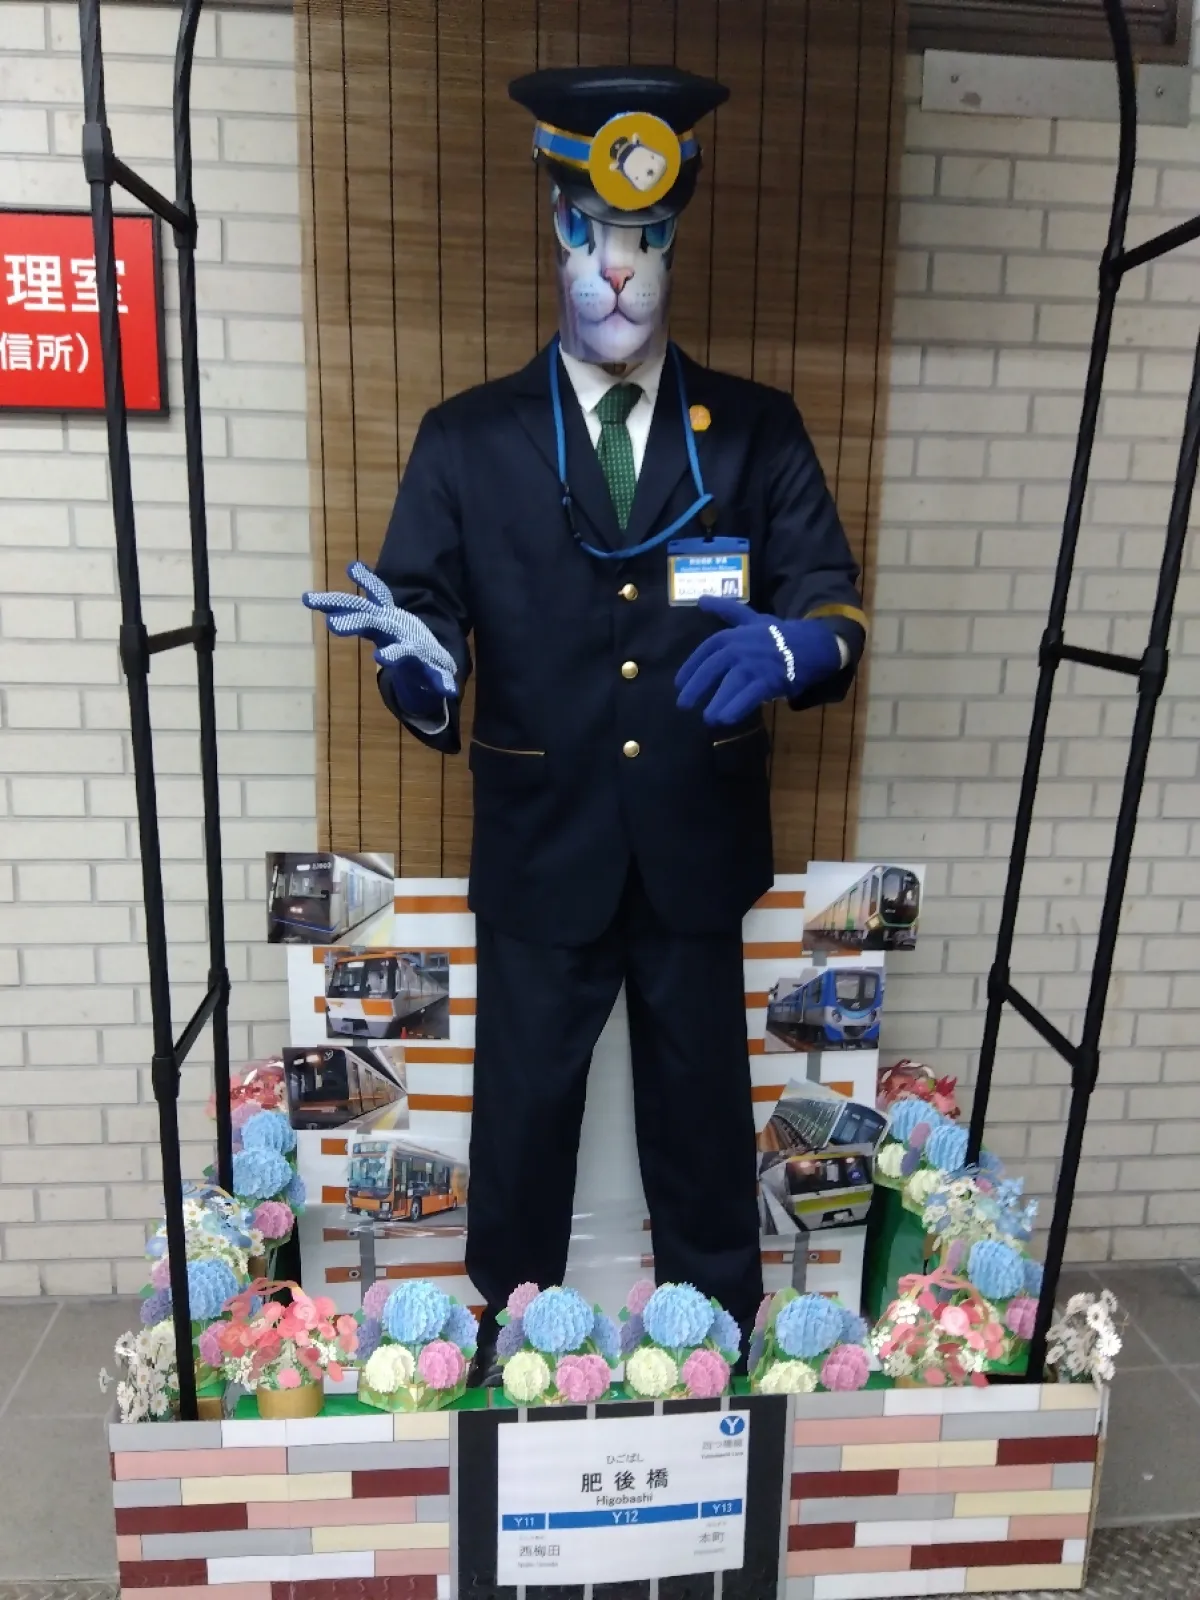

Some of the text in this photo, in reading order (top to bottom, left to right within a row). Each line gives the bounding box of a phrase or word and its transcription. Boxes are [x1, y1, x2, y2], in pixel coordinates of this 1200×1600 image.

[724, 1416, 741, 1435] Y
[606, 1453, 645, 1465] ひごばし
[581, 1468, 669, 1493] 肥後橋
[596, 1492, 654, 1507] Higobashi
[712, 1502, 733, 1515] Y13
[513, 1516, 535, 1528] Y11
[612, 1509, 640, 1525] Y12
